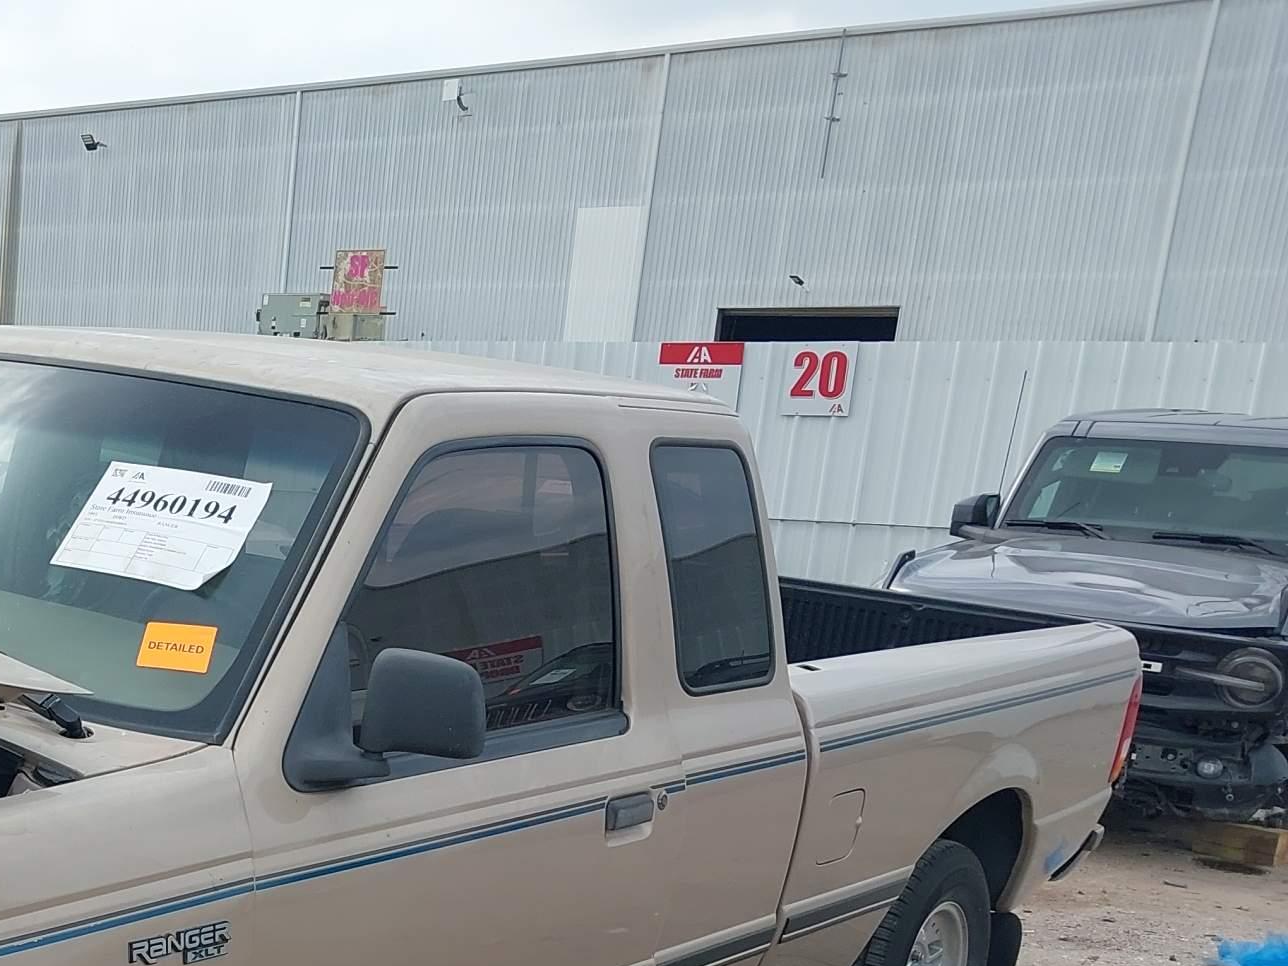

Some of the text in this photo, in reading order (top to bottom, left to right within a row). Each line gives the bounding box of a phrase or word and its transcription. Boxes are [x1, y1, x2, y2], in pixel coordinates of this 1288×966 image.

[674, 368, 723, 378] STATE FARM
[789, 350, 849, 400] 20
[106, 486, 238, 524] 44960194
[148, 641, 205, 654] DETAILED
[128, 921, 232, 966] RANGER
[192, 945, 226, 960] XLT
